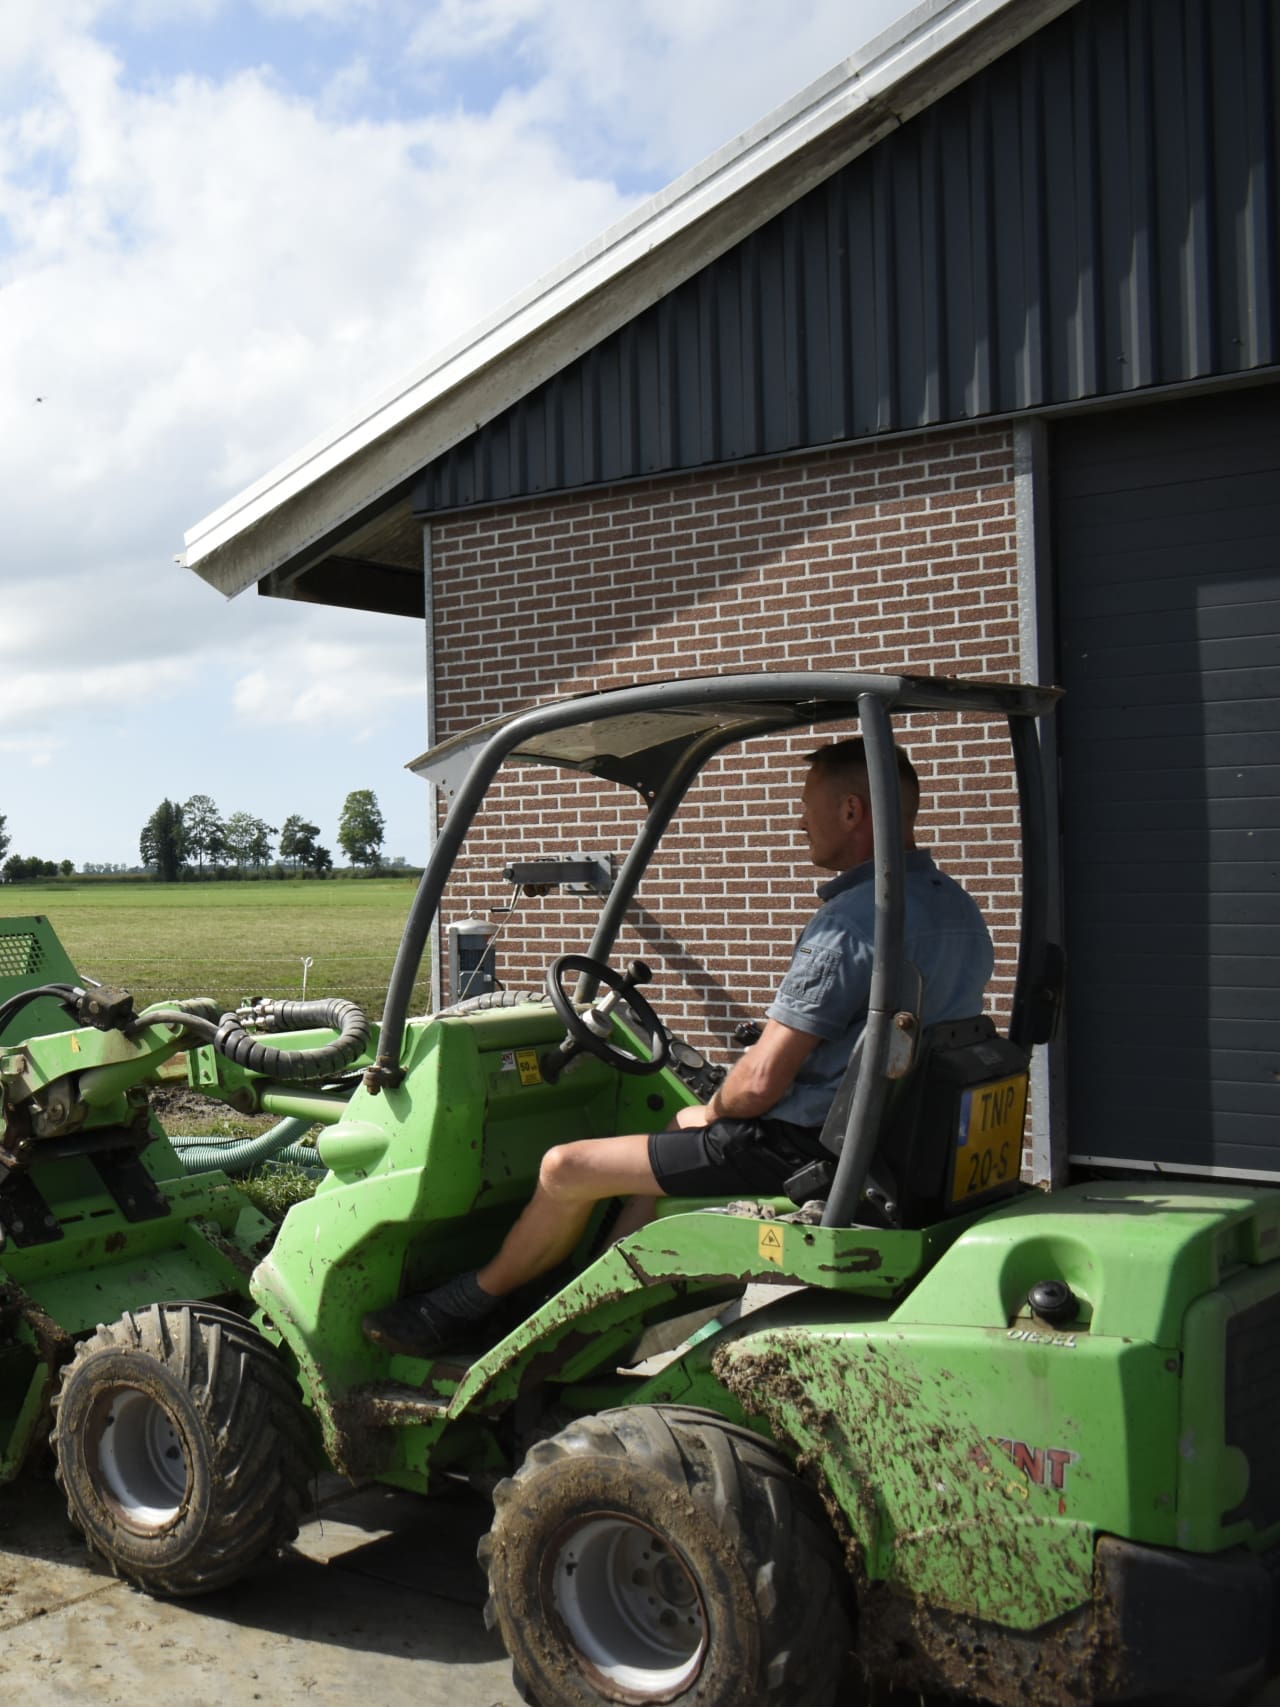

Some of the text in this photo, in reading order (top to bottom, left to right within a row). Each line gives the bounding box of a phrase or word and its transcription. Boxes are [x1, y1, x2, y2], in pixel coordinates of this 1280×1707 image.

[981, 1086, 1015, 1132] TNP
[967, 1141, 1009, 1192] 20-S
[1007, 1329, 1077, 1349] DIESEL
